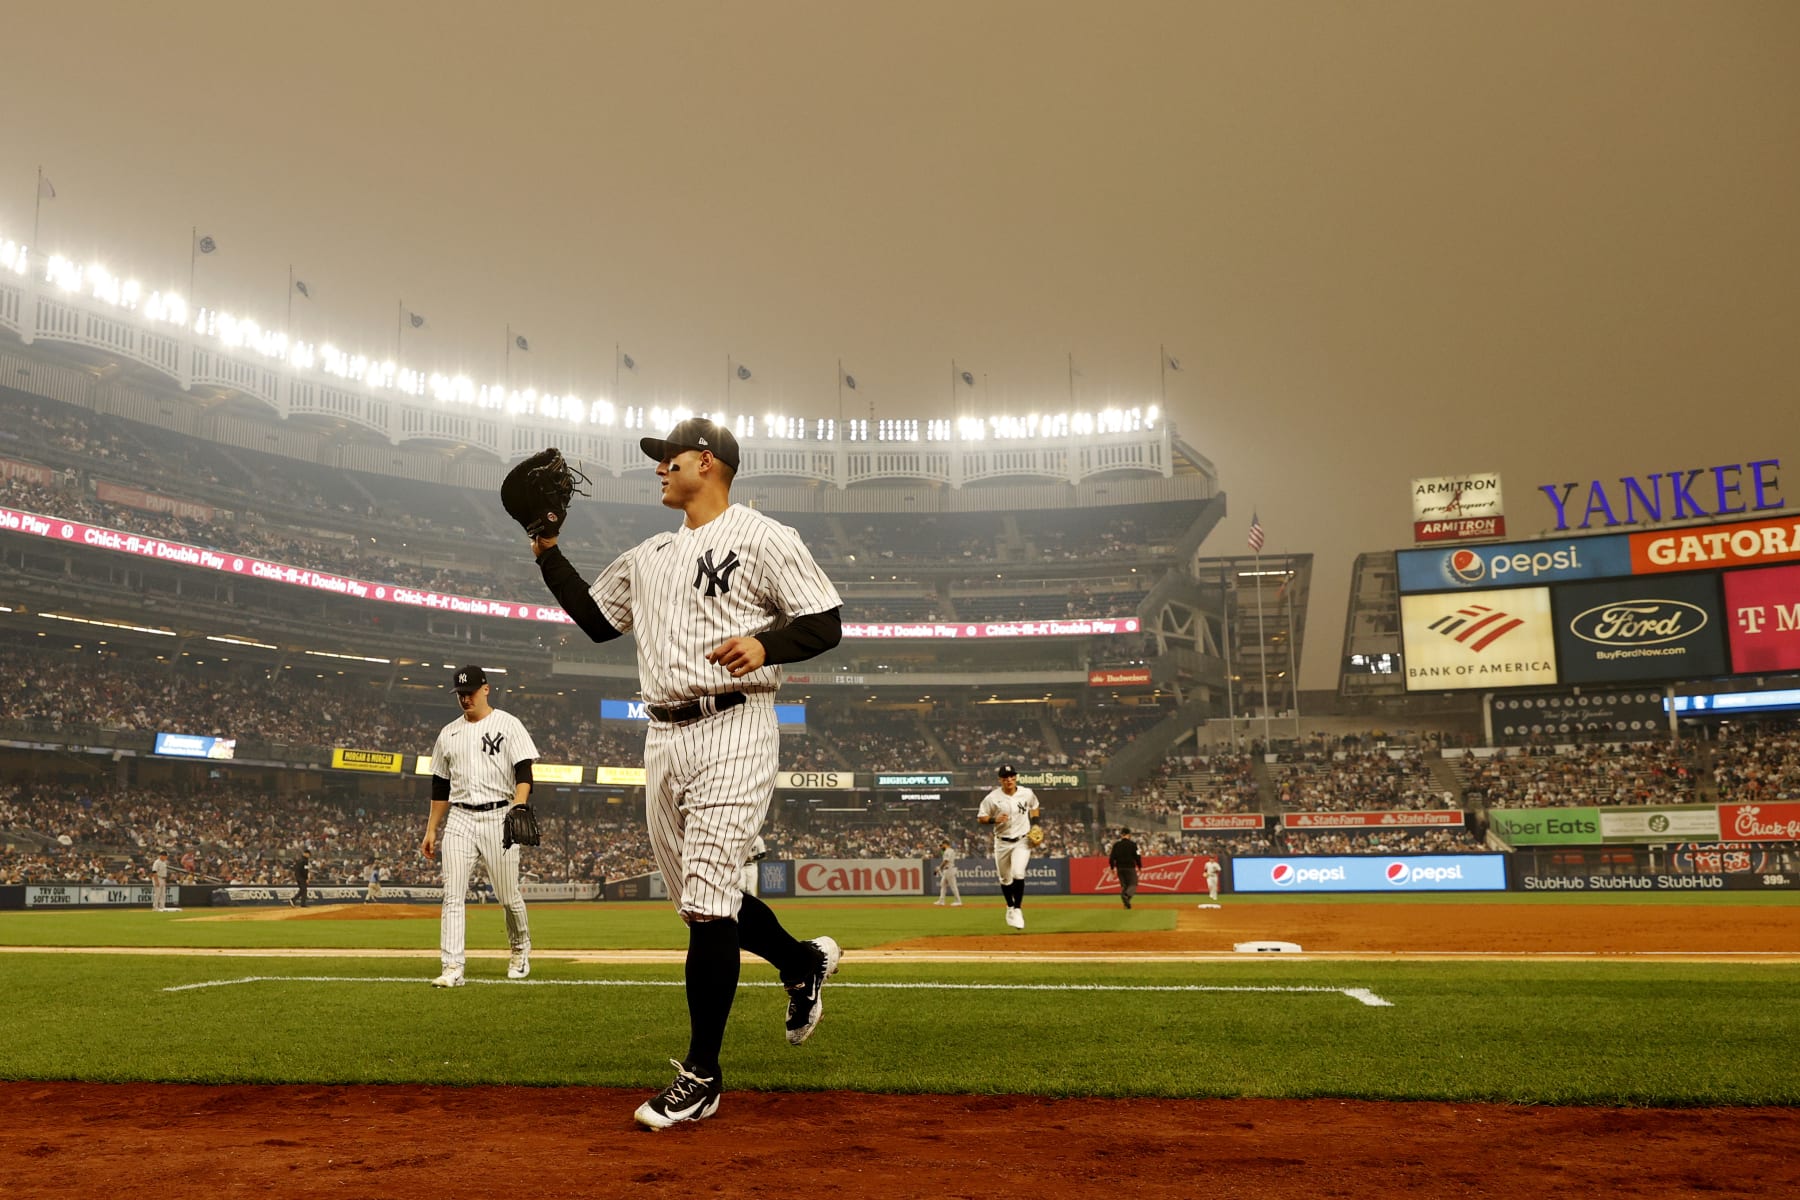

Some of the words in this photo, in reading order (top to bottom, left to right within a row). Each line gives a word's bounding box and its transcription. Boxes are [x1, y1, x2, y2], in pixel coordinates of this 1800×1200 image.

[1416, 480, 1496, 495] ARMITRON
[1538, 459, 1785, 531] YANKEE
[21, 515, 50, 536] Play
[1422, 519, 1496, 533] ARMITRON
[157, 543, 199, 564] Double
[200, 551, 225, 570] Play
[1491, 545, 1578, 579] pepsi
[311, 575, 347, 592] Double
[347, 581, 367, 597] Play
[450, 598, 488, 614] Double
[489, 604, 511, 617] Play
[1050, 621, 1092, 634] Double
[1092, 620, 1116, 634] Play
[1594, 606, 1682, 639] Ford
[841, 625, 893, 637] hick-fil-A
[894, 625, 934, 637] Double
[934, 625, 958, 638] Play
[1596, 646, 1686, 660] BuyFordNow.com
[1409, 666, 1451, 678] BANK
[1456, 665, 1475, 676] OF
[1479, 661, 1552, 674] AMERICA
[1107, 674, 1148, 683] Budweiser
[790, 773, 838, 787] ORIS
[927, 776, 950, 785] TEA
[1045, 772, 1079, 786] Spring
[1495, 819, 1542, 835] Uber
[1546, 818, 1597, 834] Eats
[765, 865, 783, 874] NEW
[935, 865, 1000, 878] ntefior
[1296, 865, 1346, 883] pepsi
[1411, 864, 1463, 882] pepsi
[762, 872, 784, 882] YORK
[797, 863, 920, 892] Canon
[1524, 876, 1585, 889] StubHub
[1590, 876, 1651, 889] StubHub
[1657, 875, 1723, 888] StubHub
[1763, 875, 1783, 885] 399
[40, 887, 51, 895] TRY
[53, 887, 66, 895] OUR
[765, 880, 782, 889] LIFE
[33, 895, 50, 903] SOFT
[250, 890, 274, 899] COOL
[340, 889, 362, 898] COOL
[425, 889, 443, 898] COO
